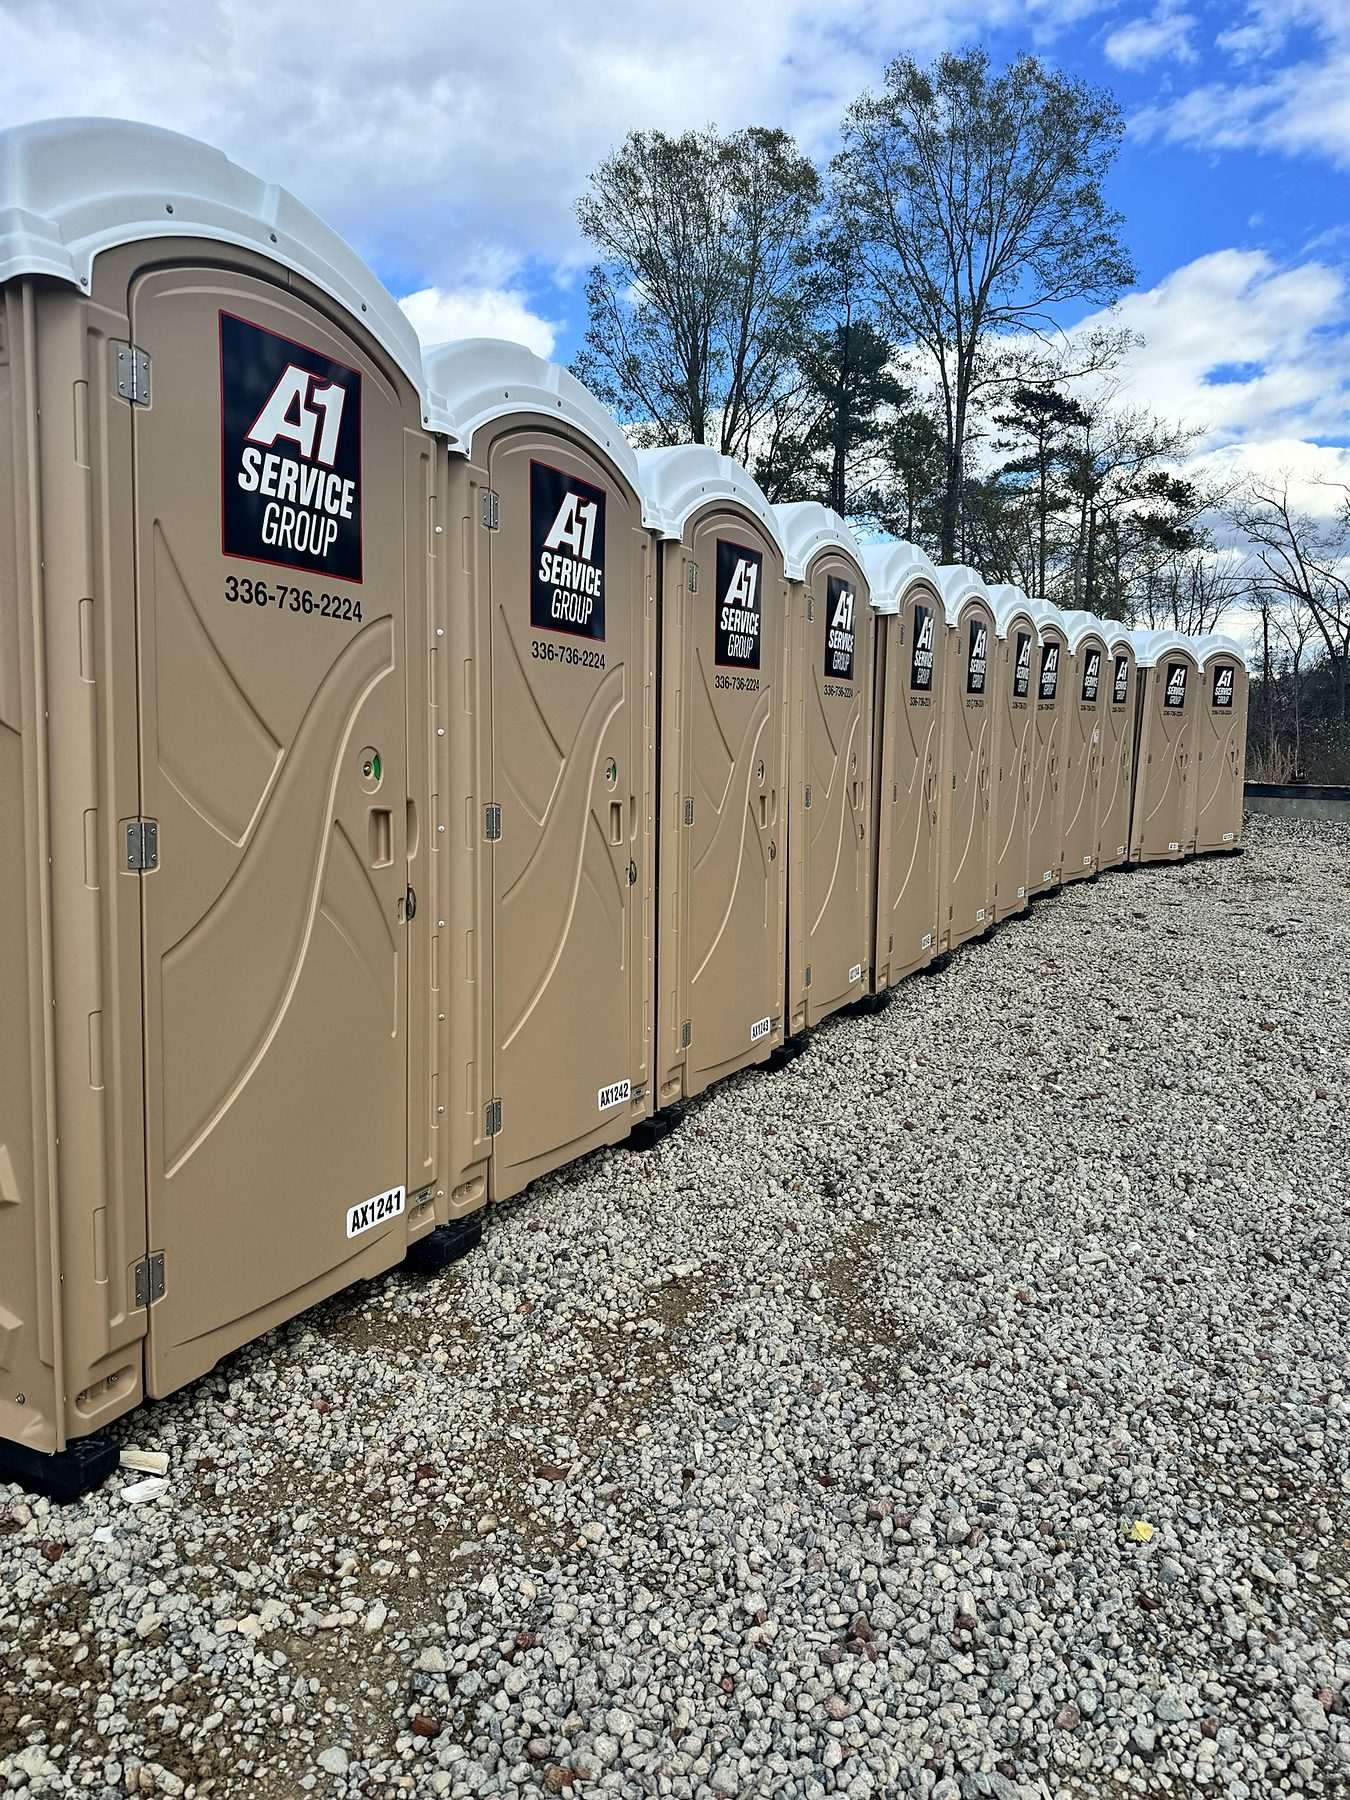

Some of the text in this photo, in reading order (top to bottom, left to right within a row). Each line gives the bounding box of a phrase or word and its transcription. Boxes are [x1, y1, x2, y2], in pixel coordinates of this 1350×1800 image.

[247, 363, 346, 466] A1
[238, 447, 355, 519] SERVICE
[261, 502, 338, 557] GROUP
[543, 492, 598, 561] A1
[538, 551, 602, 597] SERVICE
[723, 558, 758, 609] A1
[224, 575, 363, 623] 336-736-2224
[551, 589, 593, 625] GROUP
[831, 590, 856, 630] A1
[720, 607, 759, 636] SERVICE
[917, 616, 934, 650] A1
[531, 641, 605, 670] 336-736-2224
[727, 634, 754, 659] GROUP
[828, 629, 854, 653] SERVICE
[972, 629, 987, 658] A1
[1018, 641, 1032, 666] A1
[832, 651, 850, 671] GROUP
[914, 649, 933, 668] SERVICE
[1044, 649, 1058, 671] A1
[1087, 655, 1099, 676] A1
[715, 675, 760, 692] 336-736-2224
[1167, 686, 1185, 696] SERVICE
[1169, 669, 1186, 686] A1
[1214, 687, 1232, 696] SERVICE
[1217, 670, 1233, 687] A1
[600, 1082, 629, 1108] AX1242
[351, 1190, 401, 1233] AX1241
